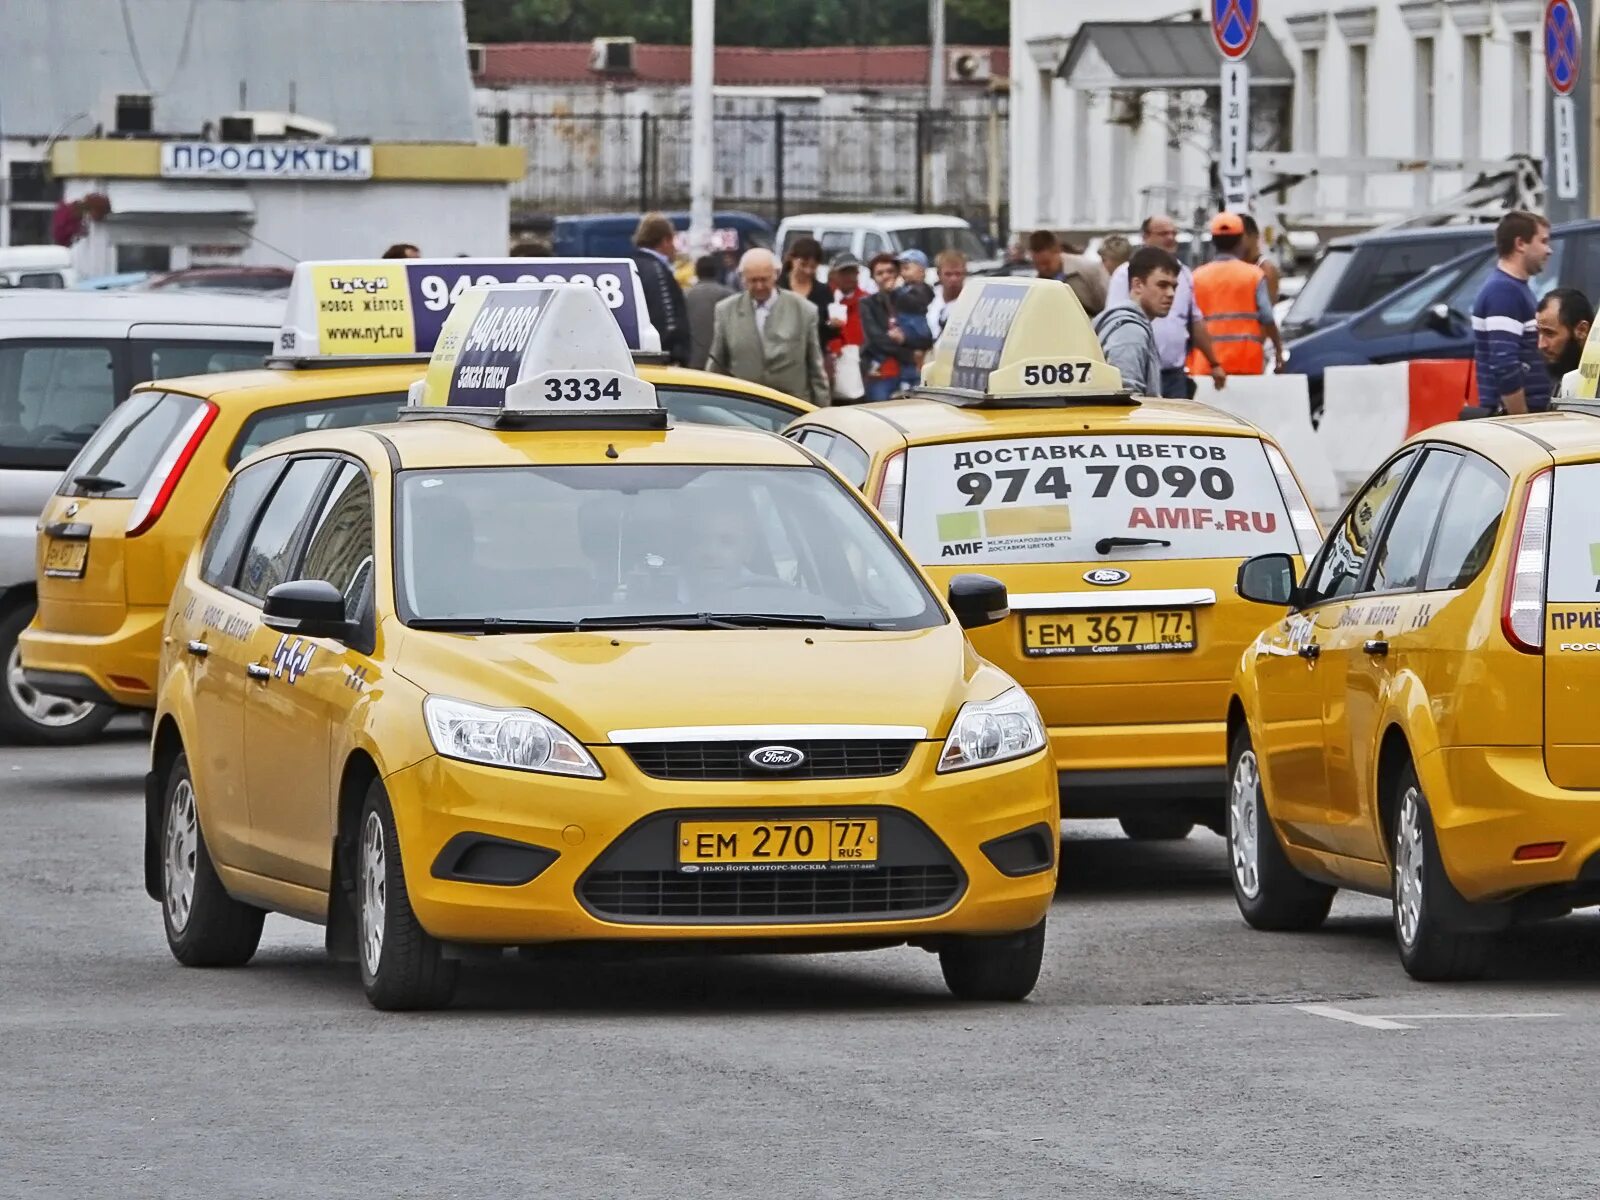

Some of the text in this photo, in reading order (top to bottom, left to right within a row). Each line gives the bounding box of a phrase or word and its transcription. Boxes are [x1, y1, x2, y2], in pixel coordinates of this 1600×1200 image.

[174, 146, 359, 171] ПРОДУКТЫ
[330, 277, 389, 294] ТАКСИ
[320, 296, 405, 312] НОВОЕ ЖЁЛТОЕ
[326, 324, 404, 344] www.nyt.ru
[1024, 362, 1092, 386] 5087
[544, 378, 622, 401] 3334
[953, 443, 1227, 471] ДОСТАВКА ЦВЕТОВ
[956, 464, 1235, 507] 974 7090
[941, 541, 983, 557] AMF
[1086, 615, 1139, 643] 367
[1156, 612, 1184, 634] 77
[1161, 634, 1182, 643] RUS
[1559, 642, 1600, 652] FOC
[762, 749, 792, 764] Ford
[752, 825, 814, 857] 270
[835, 822, 867, 848] 77
[838, 848, 863, 858] RUS
